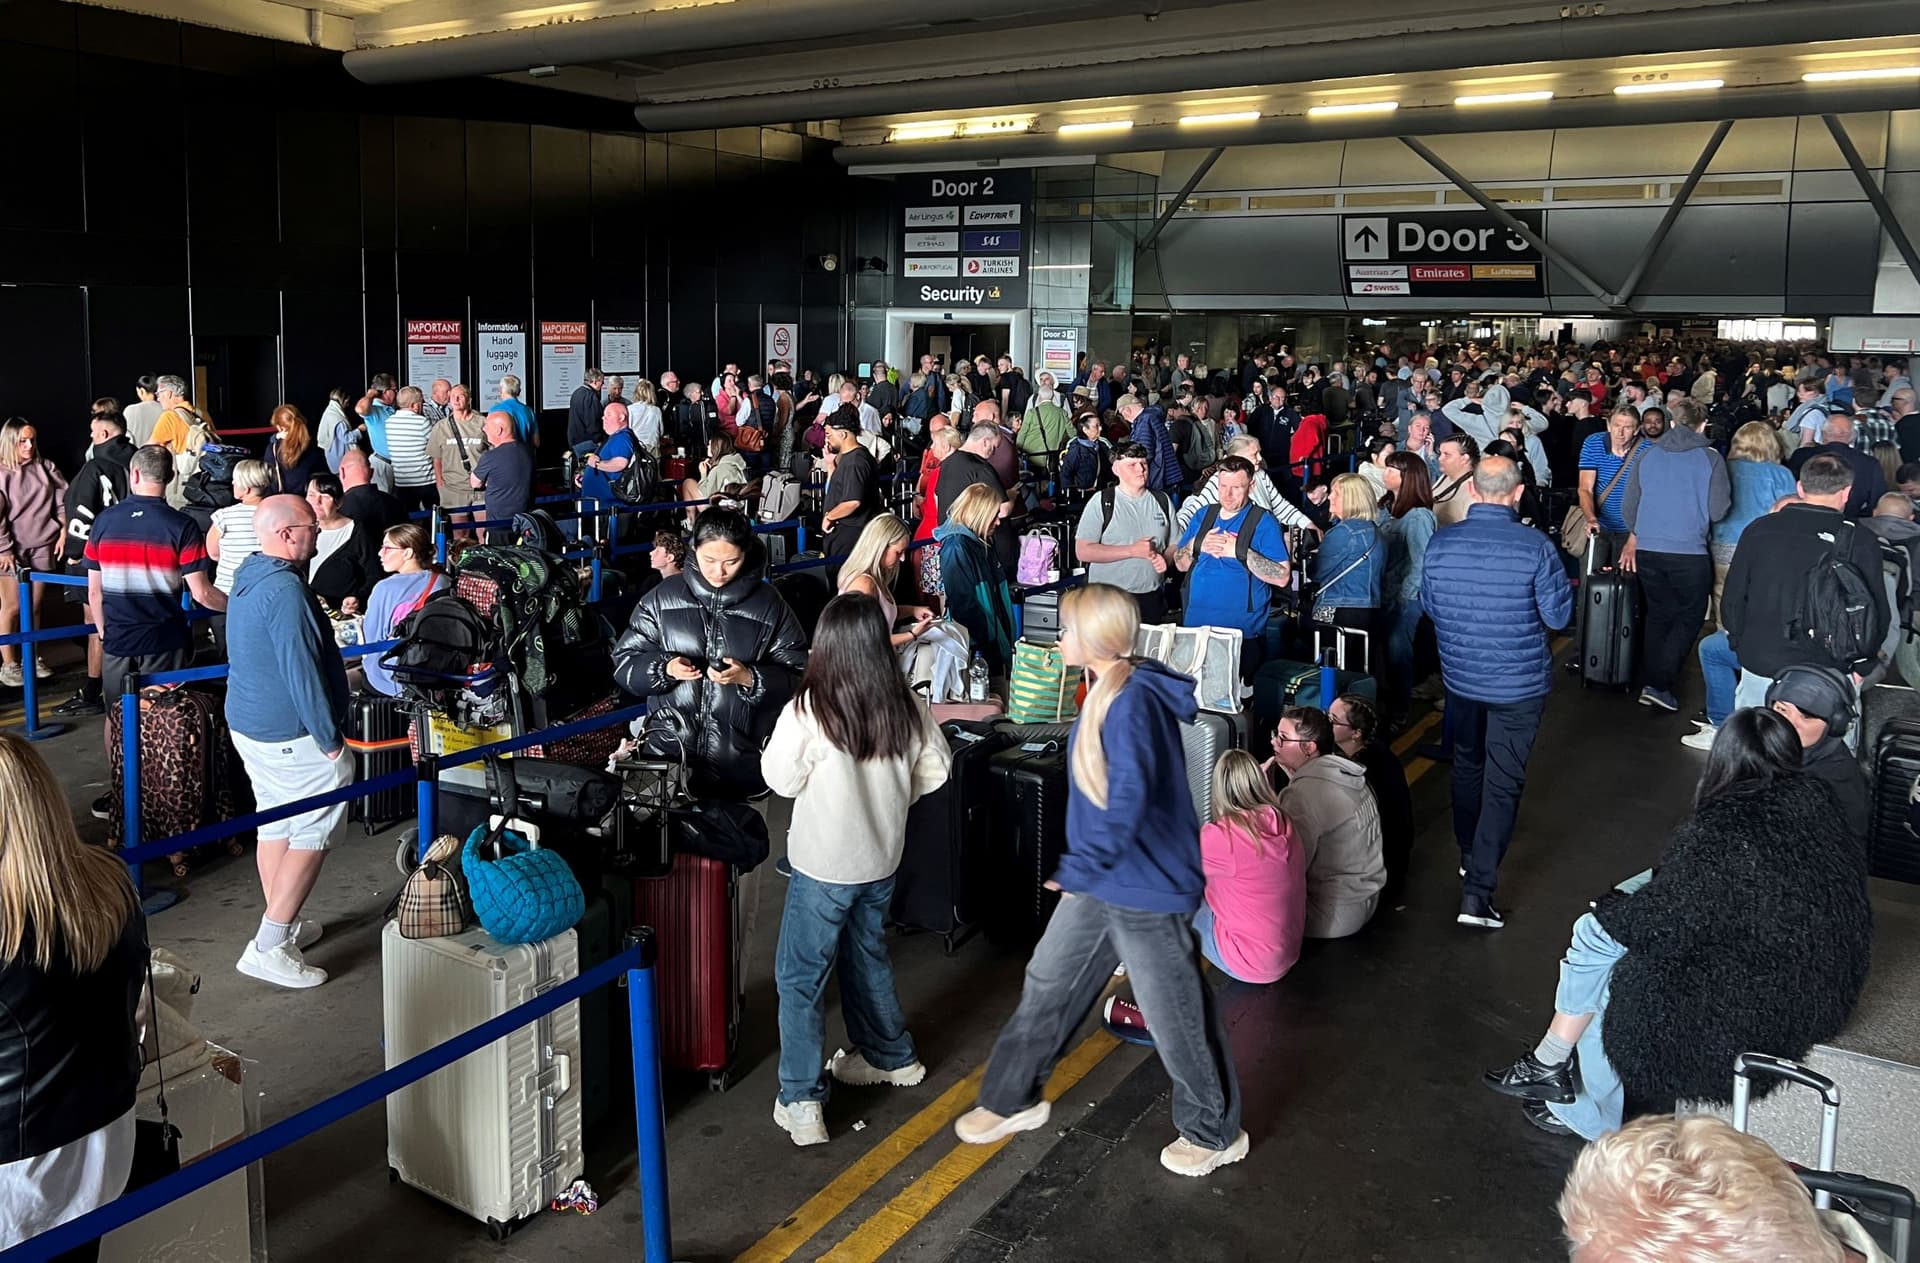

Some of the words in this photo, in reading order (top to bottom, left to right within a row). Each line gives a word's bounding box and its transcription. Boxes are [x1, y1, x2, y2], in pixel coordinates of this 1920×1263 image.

[932, 179, 978, 197] Door
[982, 177, 994, 195] 2
[921, 212, 944, 222] Lingus
[981, 235, 1001, 246] SAS
[1398, 222, 1495, 252] Door
[1506, 220, 1531, 251] 3
[1355, 268, 1389, 276] Austrian
[1415, 269, 1465, 278] Emirates
[920, 285, 985, 304] Security
[407, 322, 460, 333] IMPORTANT
[478, 322, 519, 331] Information
[542, 324, 585, 334] IMPORTANT
[1043, 330, 1061, 338] Door
[1061, 330, 1067, 338] 3
[491, 336, 513, 345] Hand
[486, 349, 519, 360] luggage
[492, 362, 513, 373] only?
